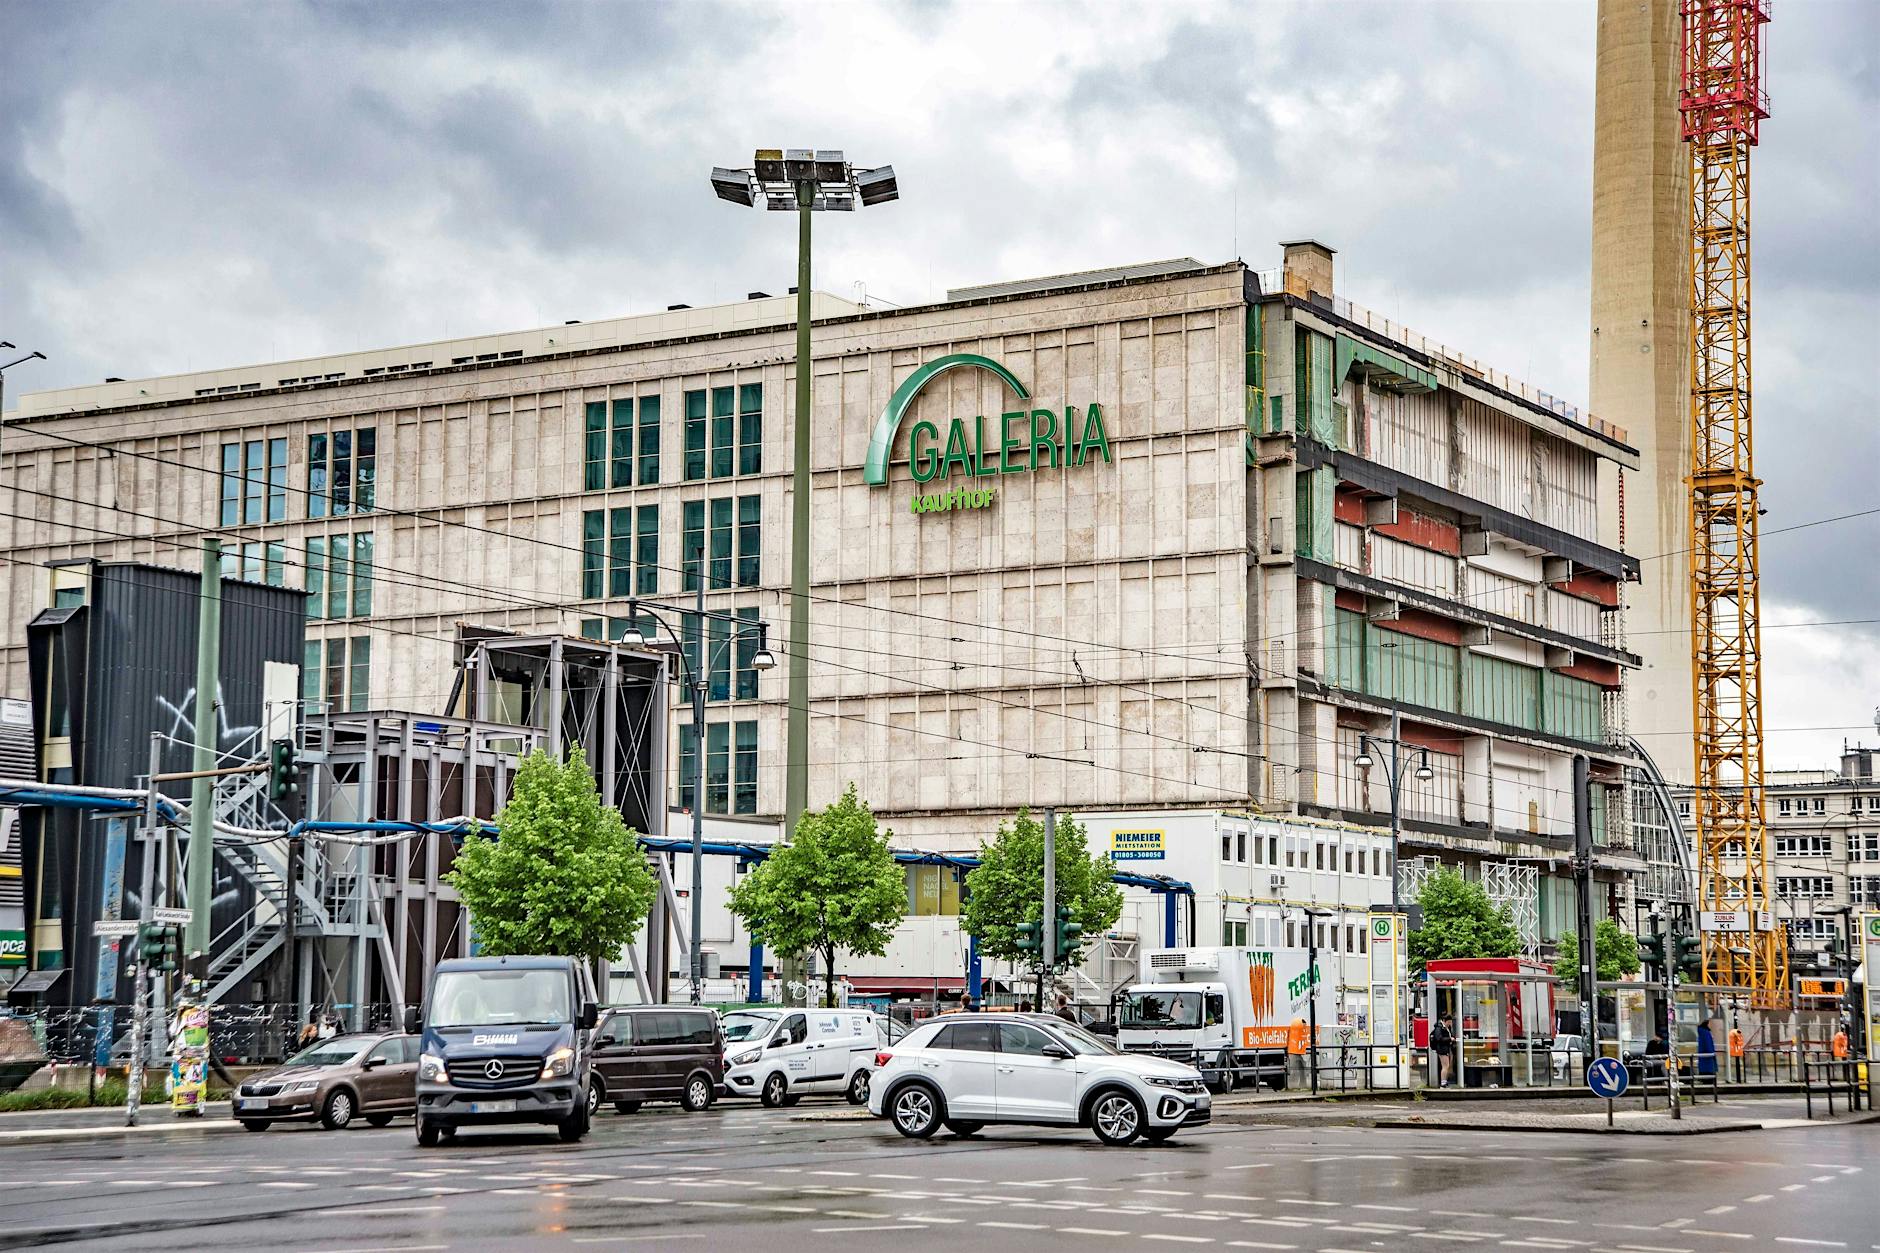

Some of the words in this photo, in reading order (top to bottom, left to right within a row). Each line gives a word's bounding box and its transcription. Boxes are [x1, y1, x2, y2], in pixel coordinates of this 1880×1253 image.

[909, 403, 1112, 483] GALERIA
[1115, 833, 1161, 842] NIEMEIER
[1248, 1030, 1288, 1045] Bio-Vielfalt?
